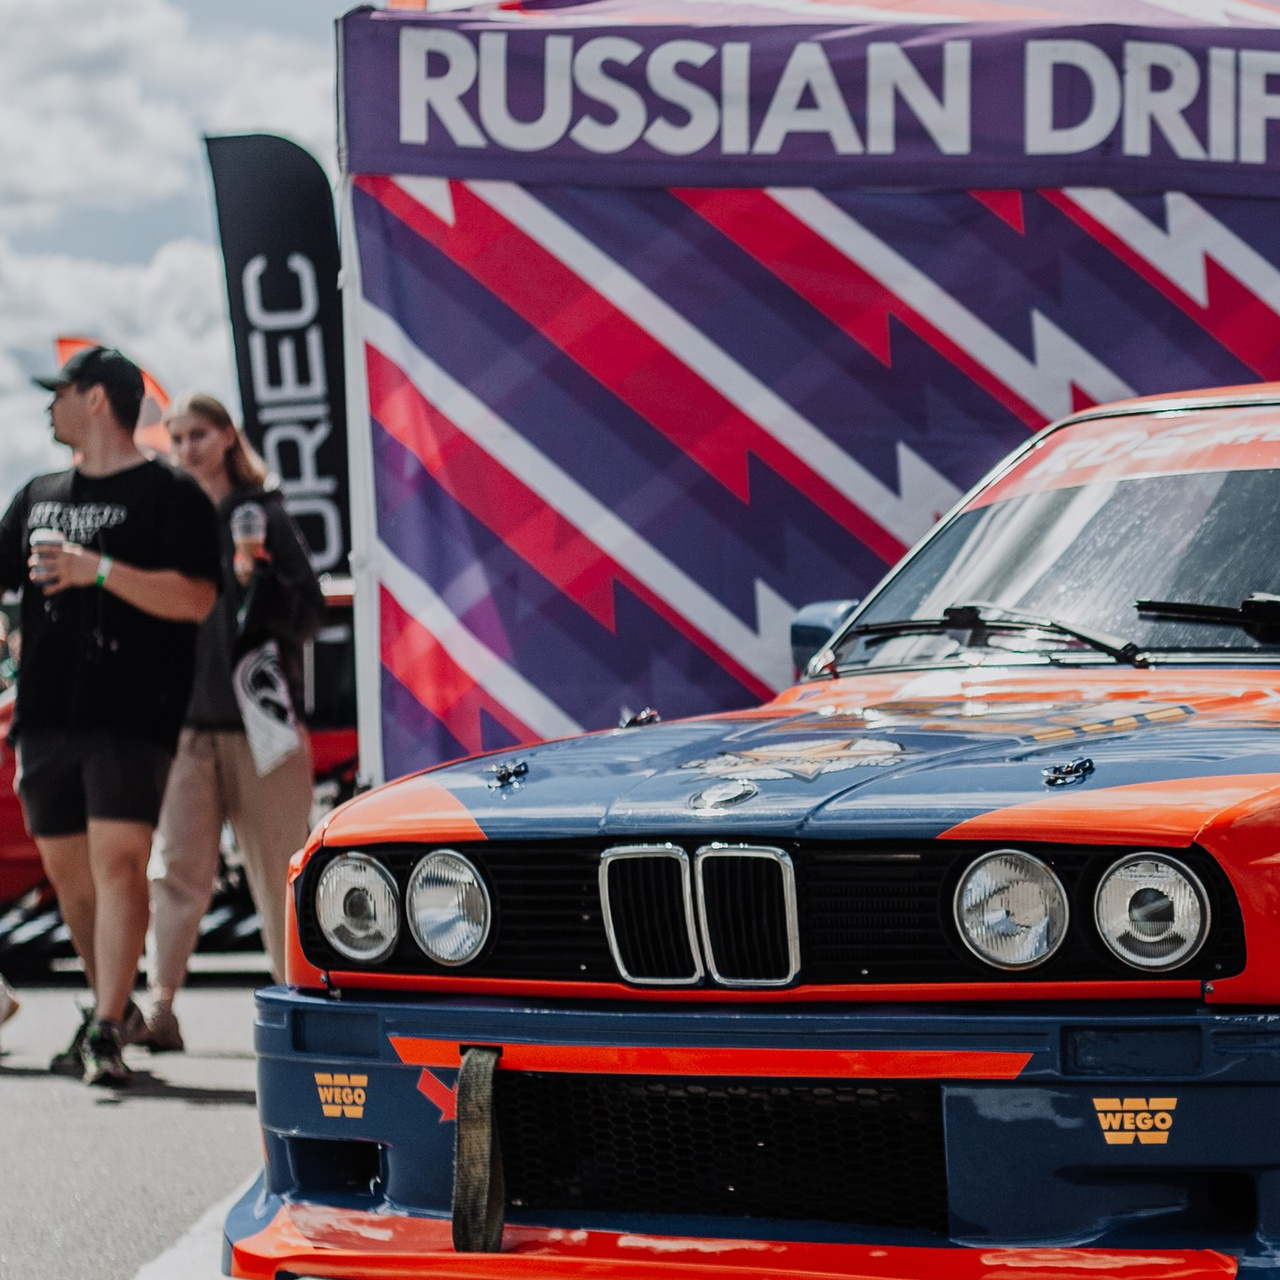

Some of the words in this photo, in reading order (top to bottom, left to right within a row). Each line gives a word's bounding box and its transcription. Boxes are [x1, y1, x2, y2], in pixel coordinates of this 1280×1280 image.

[400, 34, 971, 154] RUSSIAN
[318, 1086, 367, 1105] WEGO
[1097, 1111, 1173, 1130] WEGO
